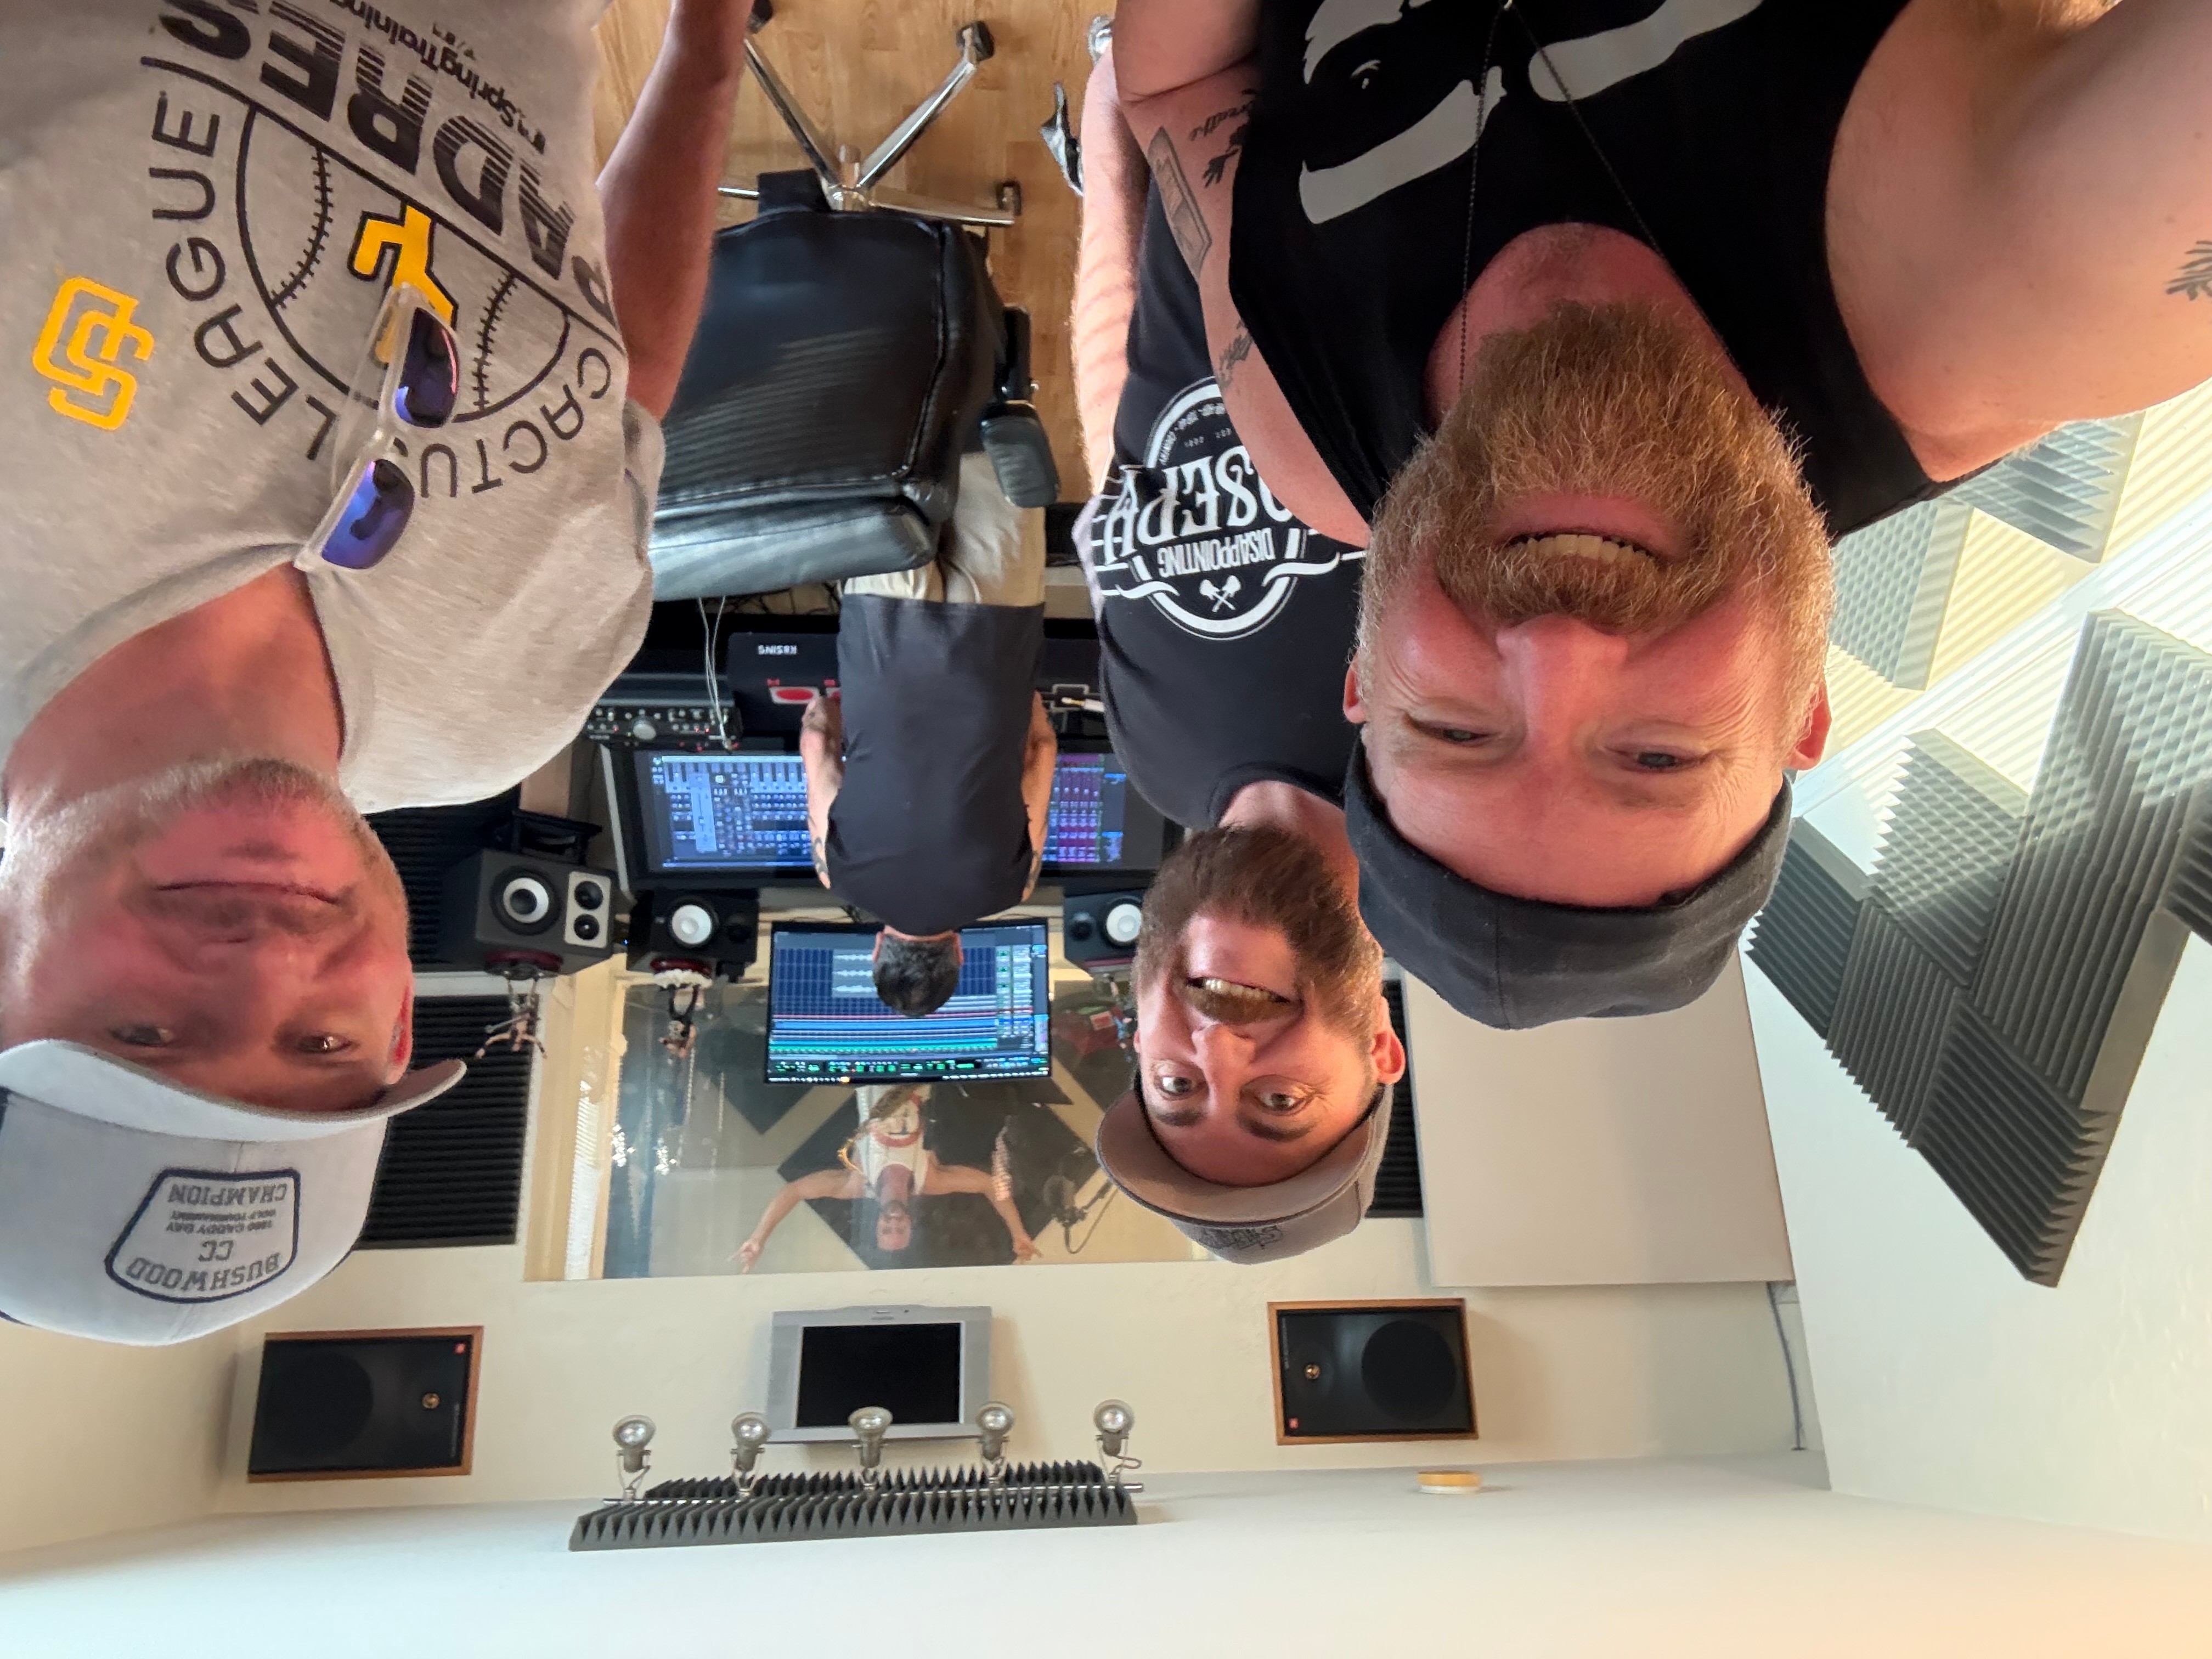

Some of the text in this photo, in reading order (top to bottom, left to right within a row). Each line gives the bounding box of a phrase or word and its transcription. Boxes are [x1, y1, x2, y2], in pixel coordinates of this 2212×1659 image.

[148, 95, 613, 499] CACTU LEAGUE
[1103, 445, 1293, 566] OSEPH
[1156, 527, 1276, 578] DISAPPOINTING
[167, 1183, 288, 1206] CHAMPION
[125, 1252, 280, 1292] BUSHWOOD
[198, 1240, 234, 1262] CC
